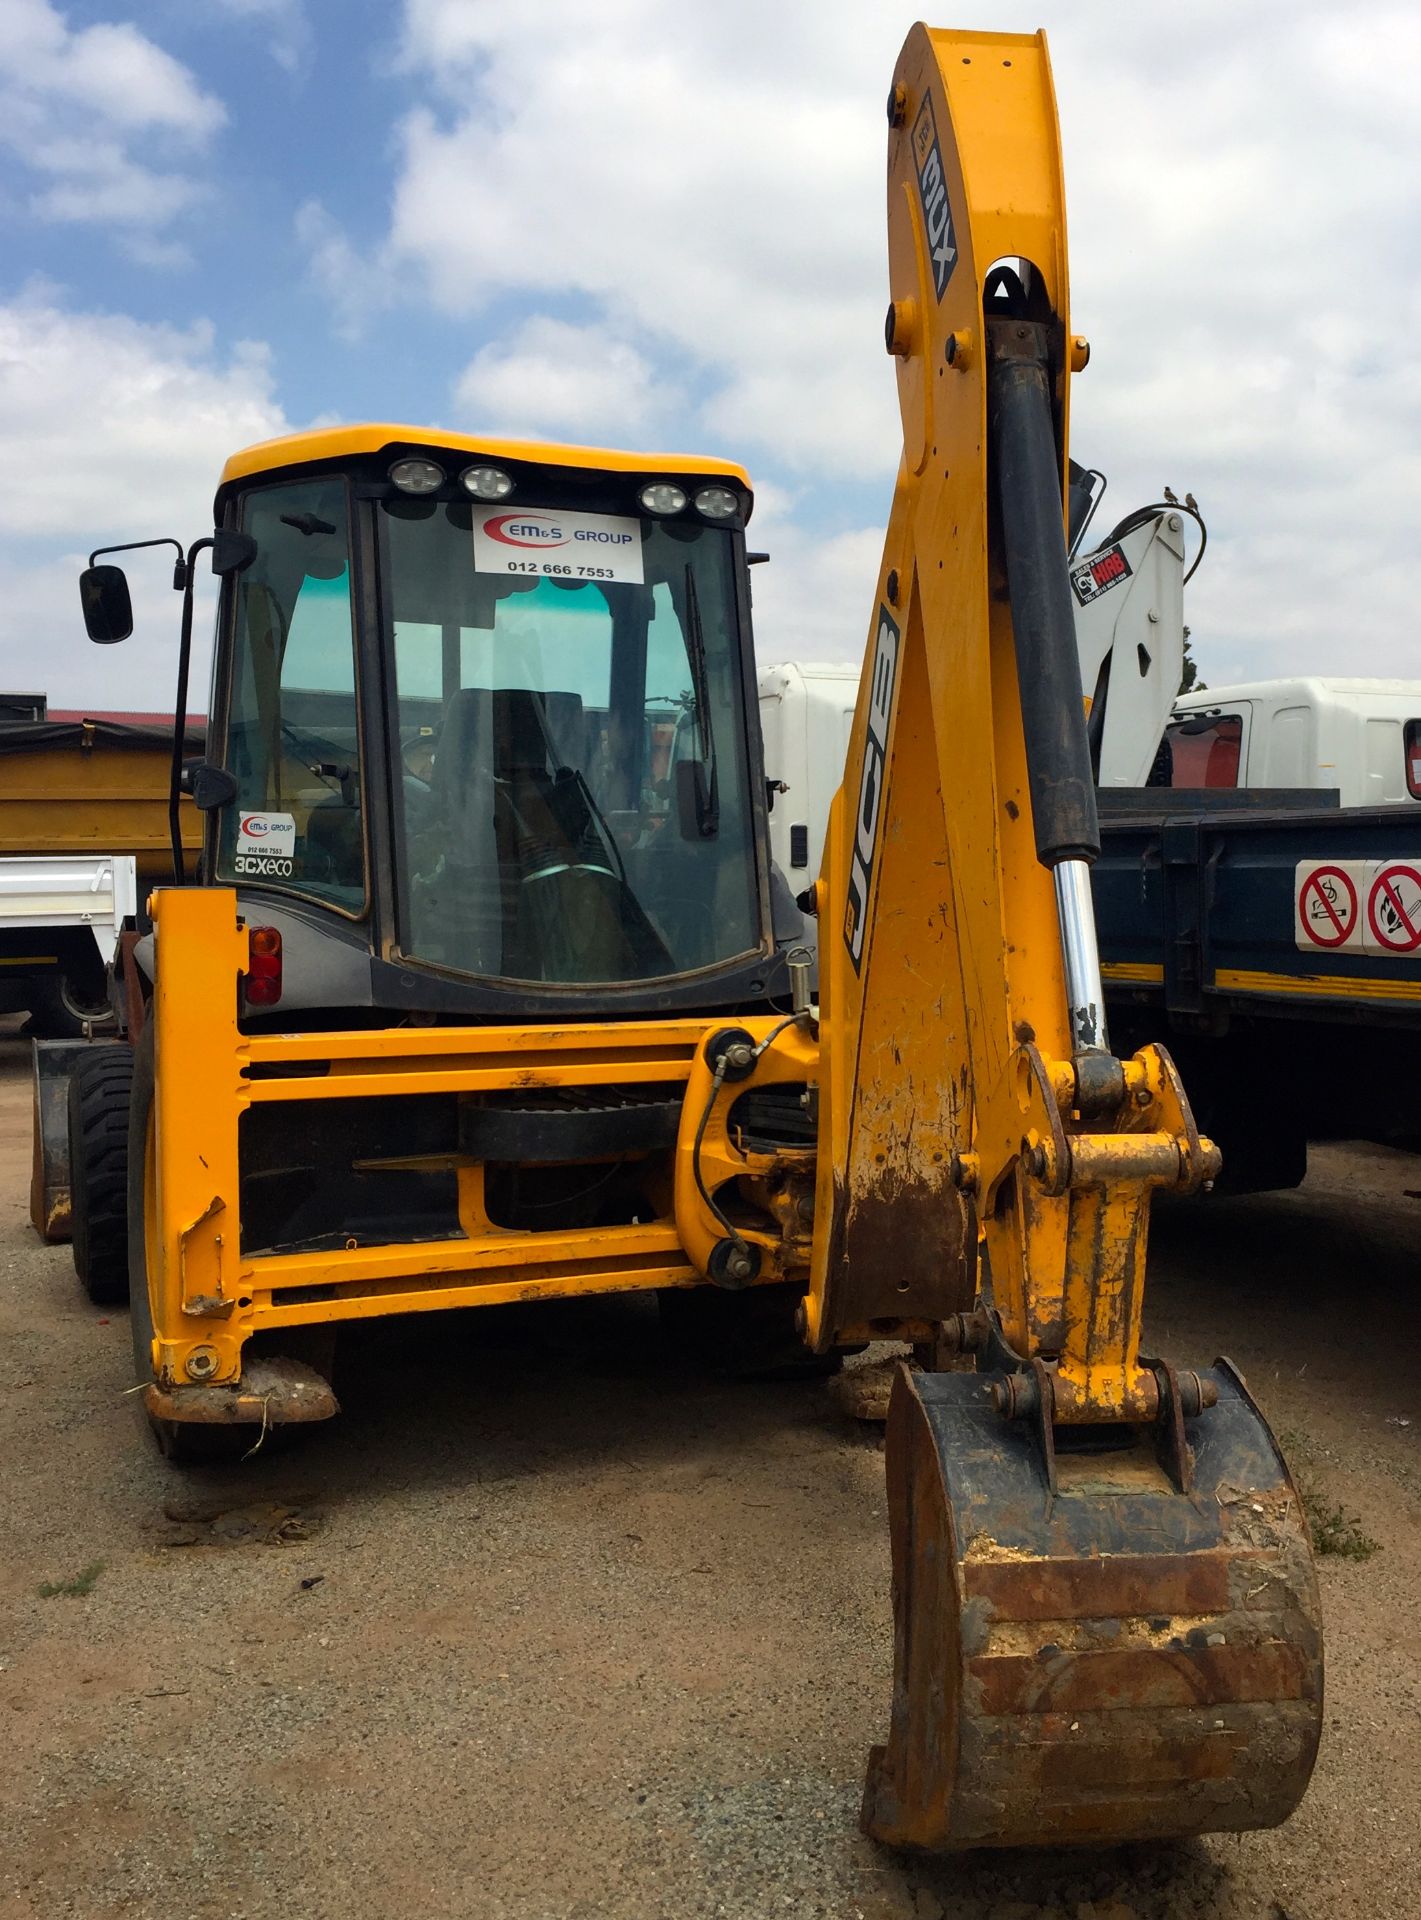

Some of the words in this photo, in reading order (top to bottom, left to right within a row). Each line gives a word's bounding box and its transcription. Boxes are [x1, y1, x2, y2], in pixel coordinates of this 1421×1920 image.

[922, 147, 956, 294] 3CX
[509, 524, 563, 539] EM&S
[573, 530, 633, 545] GROUP
[507, 561, 538, 573] 012
[542, 564, 572, 576] 666
[576, 566, 615, 579] 7553
[1091, 552, 1125, 587] HIAB
[851, 621, 896, 961] JCB
[270, 824, 293, 832] GROUP
